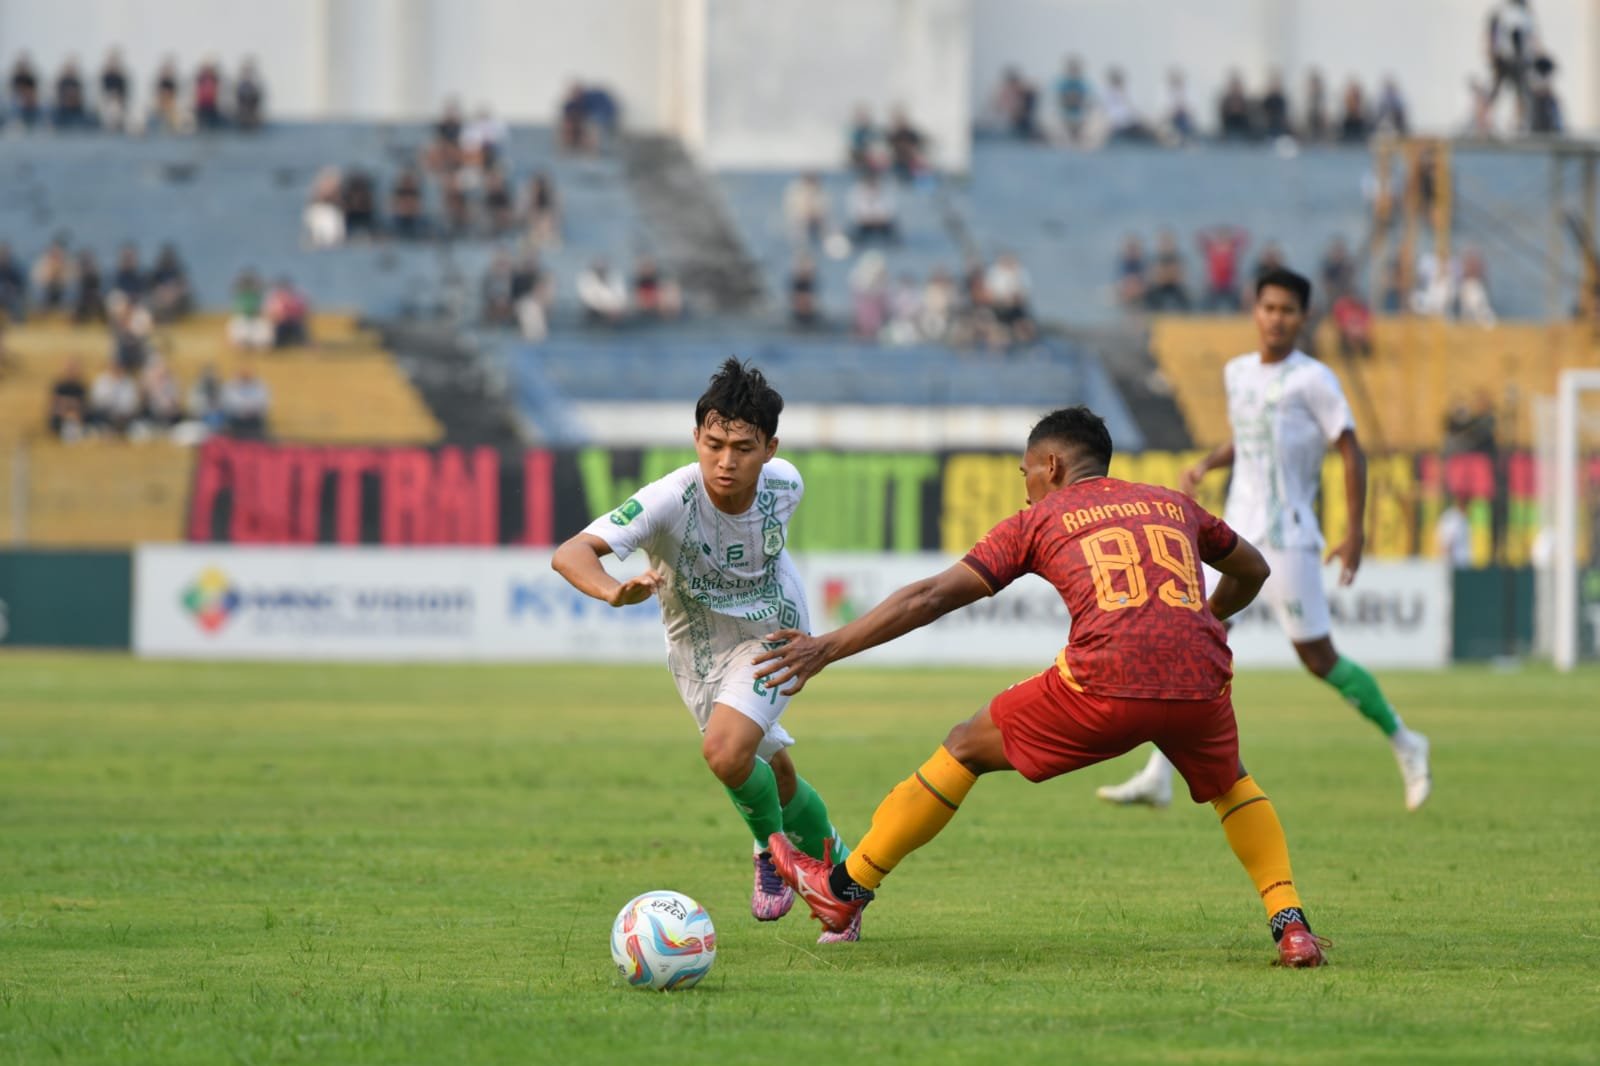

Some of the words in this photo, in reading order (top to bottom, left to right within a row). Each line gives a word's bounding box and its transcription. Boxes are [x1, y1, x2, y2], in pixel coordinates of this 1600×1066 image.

[1062, 501, 1151, 533] RAHMAD
[1152, 501, 1185, 524] TRI
[1080, 524, 1203, 611] 89
[650, 900, 686, 920] SPECS
